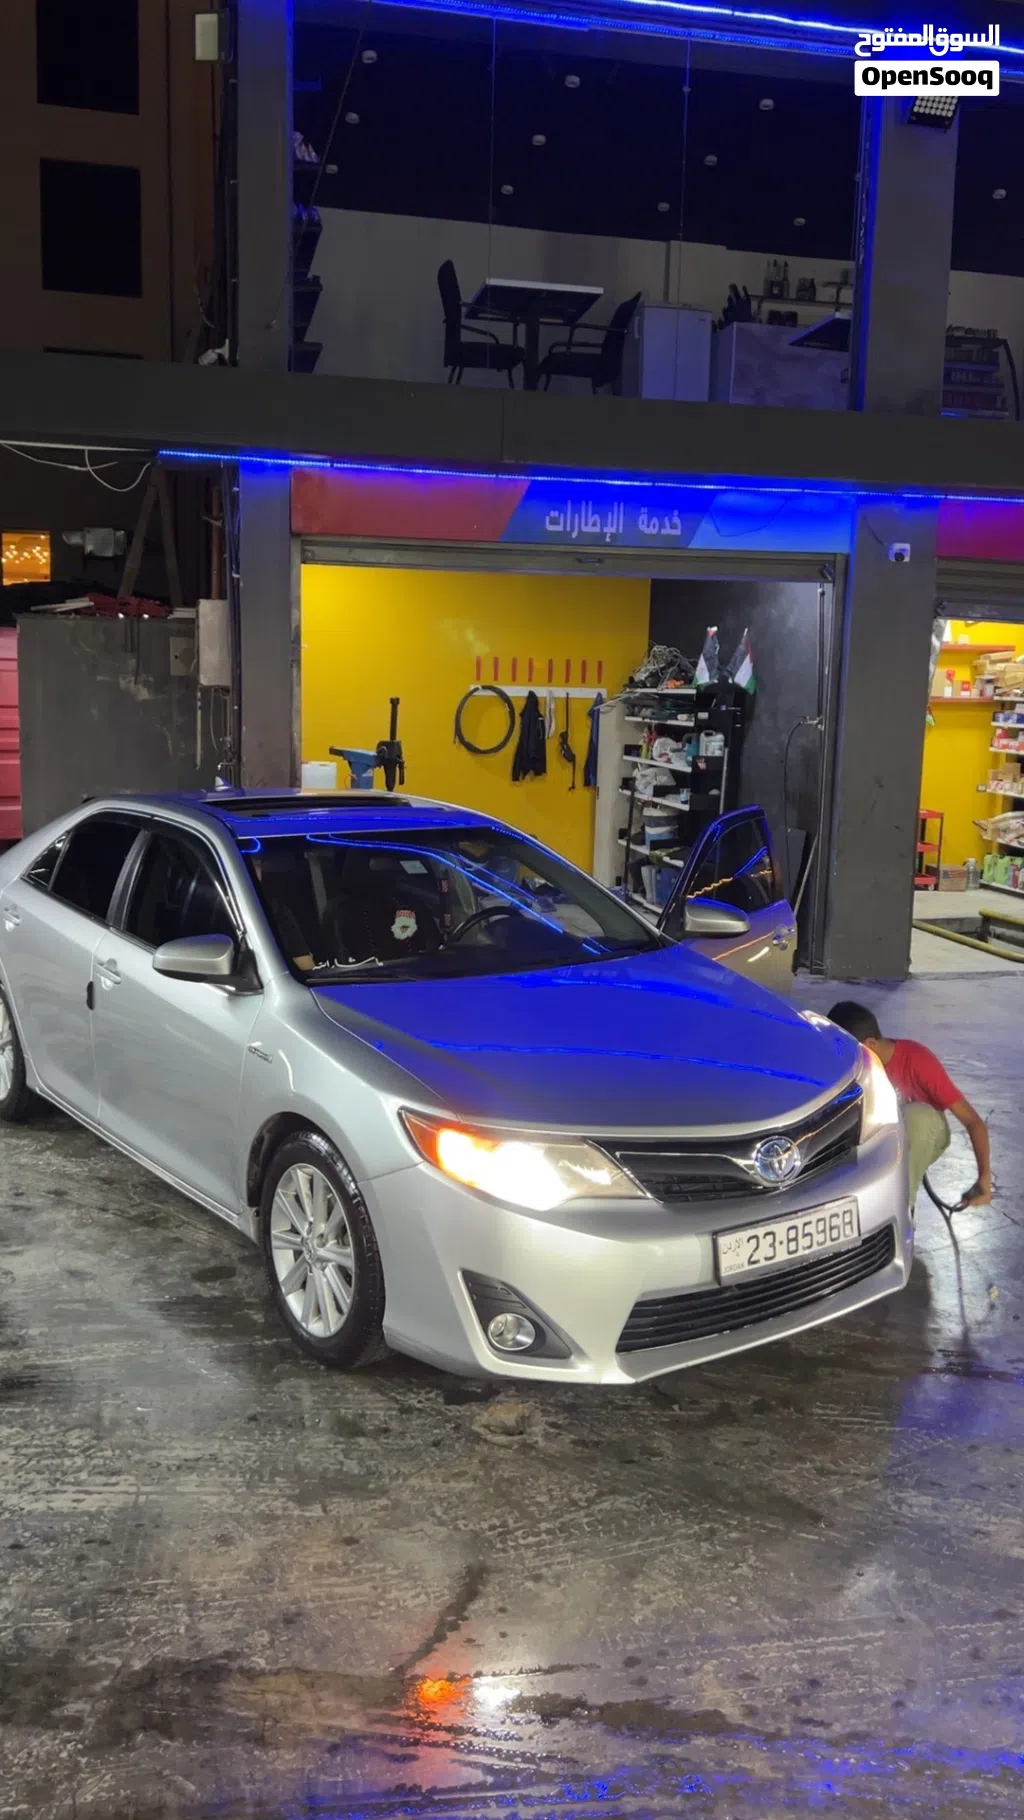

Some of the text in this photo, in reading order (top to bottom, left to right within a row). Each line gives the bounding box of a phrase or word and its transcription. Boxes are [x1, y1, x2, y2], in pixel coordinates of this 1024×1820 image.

[545, 499, 682, 542] خدمة الإطارات
[722, 1262, 745, 1274] JORDAN
